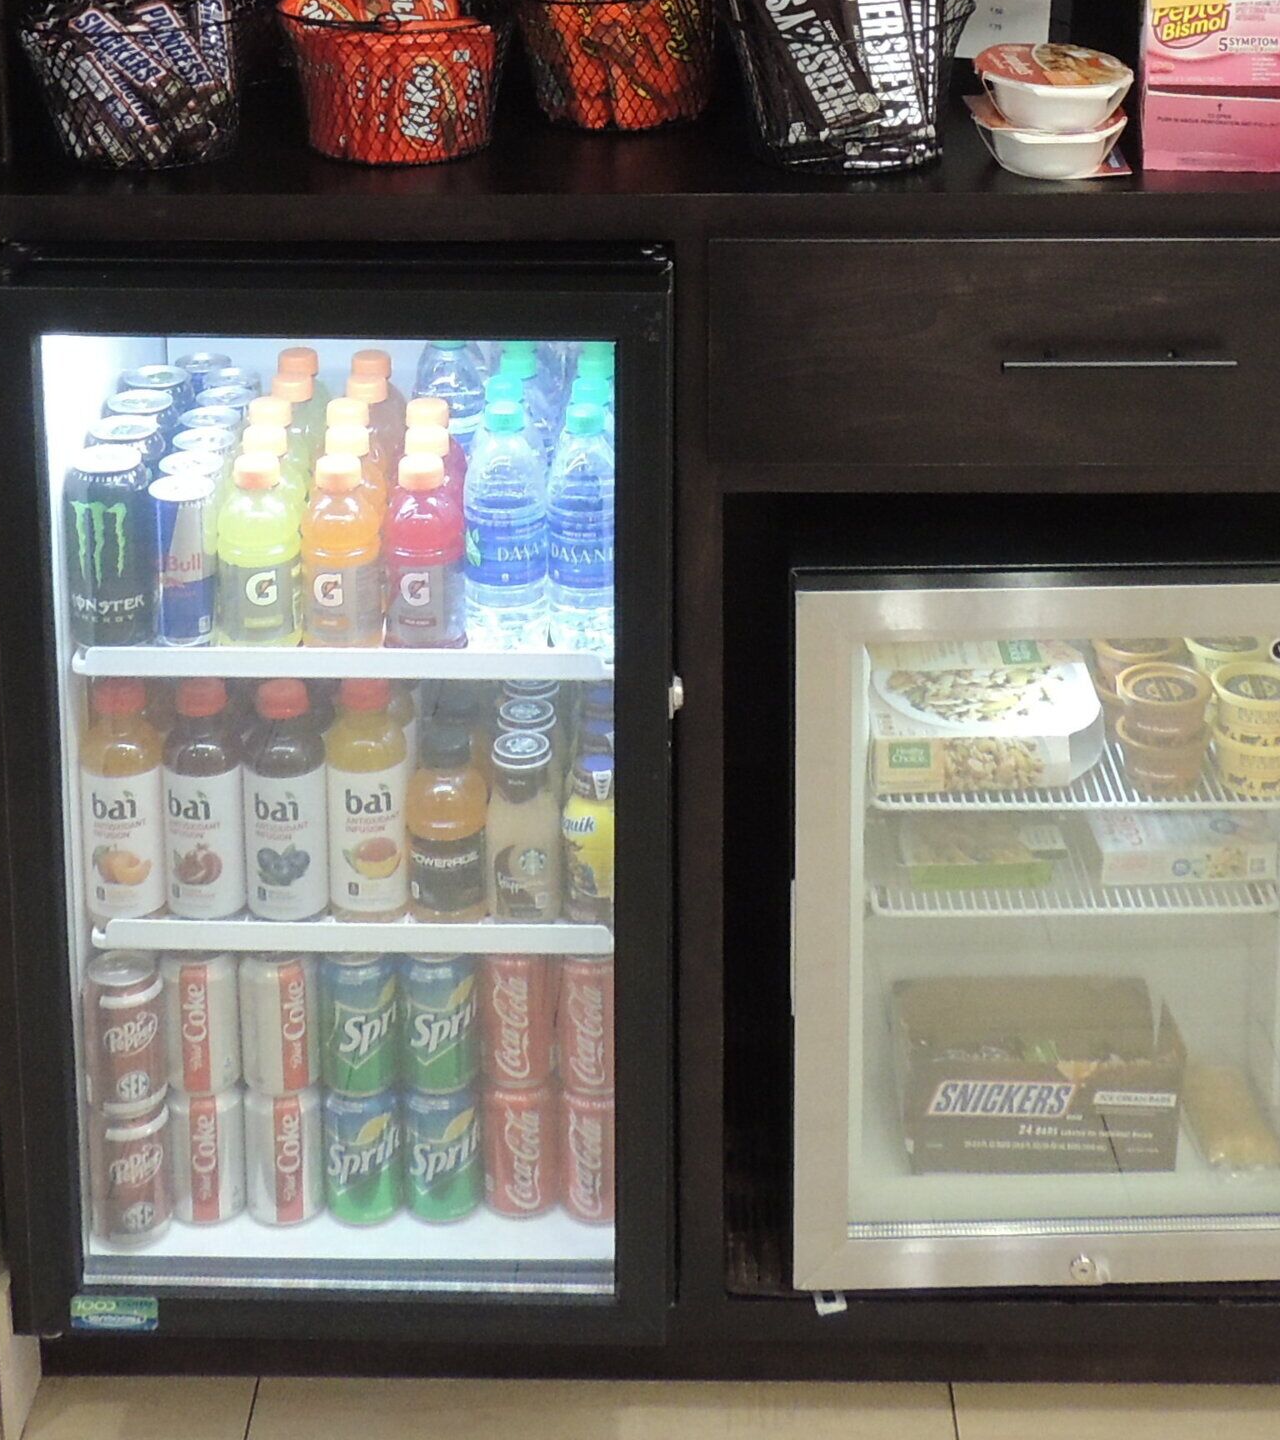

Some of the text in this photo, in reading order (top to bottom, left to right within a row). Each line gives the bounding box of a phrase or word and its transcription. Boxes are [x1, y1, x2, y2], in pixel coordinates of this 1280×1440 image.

[1160, 10, 1230, 42] Bismol
[74, 11, 162, 83] SNICKERS
[144, 4, 214, 86] PRINCESS
[1218, 37, 1279, 52] 5 SYMPTOM
[246, 570, 278, 605] G
[314, 573, 343, 607] G
[400, 573, 430, 606] G
[92, 791, 137, 820] bai
[168, 790, 211, 820] bai
[254, 791, 299, 822] bai
[345, 784, 392, 815] bai
[183, 983, 207, 1043] Coke
[283, 981, 306, 1041] Coke
[935, 1083, 1071, 1115] SNICKERS
[192, 1115, 218, 1173] Coke
[276, 1114, 300, 1174] Coke
